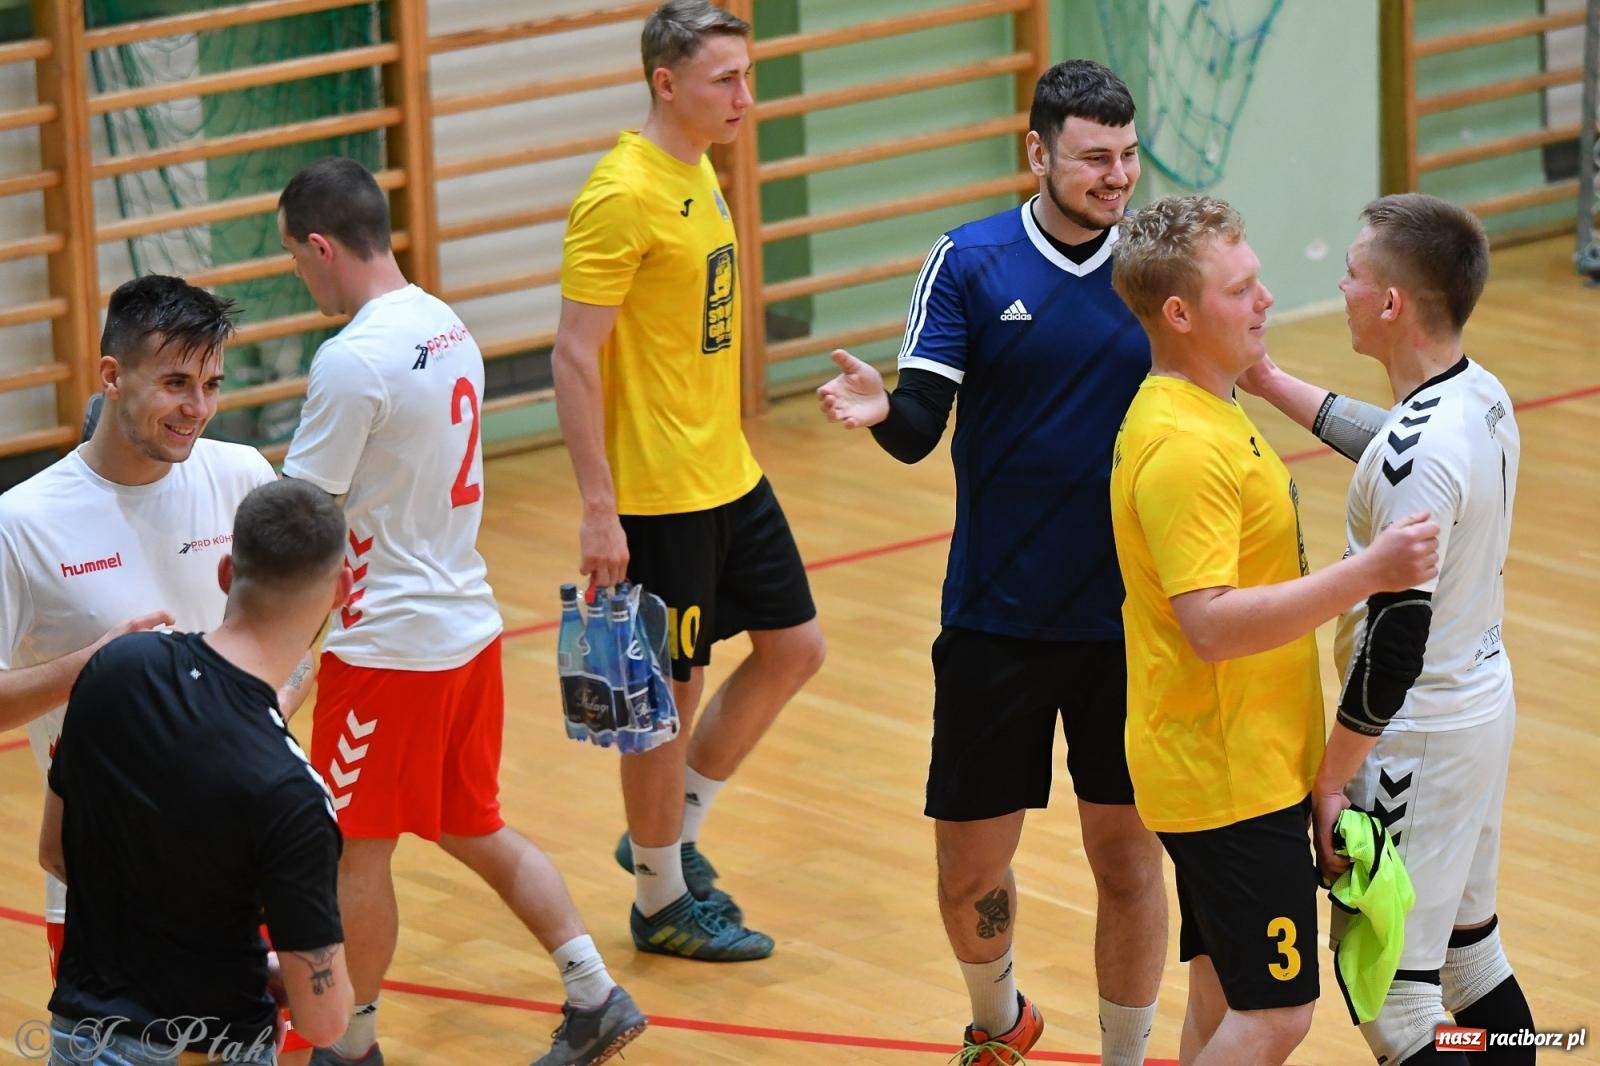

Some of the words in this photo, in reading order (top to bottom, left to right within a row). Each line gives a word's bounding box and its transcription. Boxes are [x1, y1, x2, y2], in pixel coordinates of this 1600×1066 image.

[1000, 313, 1032, 321] adidas
[450, 376, 481, 509] 2
[191, 540, 211, 549] PRD
[213, 533, 234, 545] KÜH
[61, 552, 122, 578] hummel
[669, 605, 701, 661] 10
[1267, 916, 1301, 981] 3
